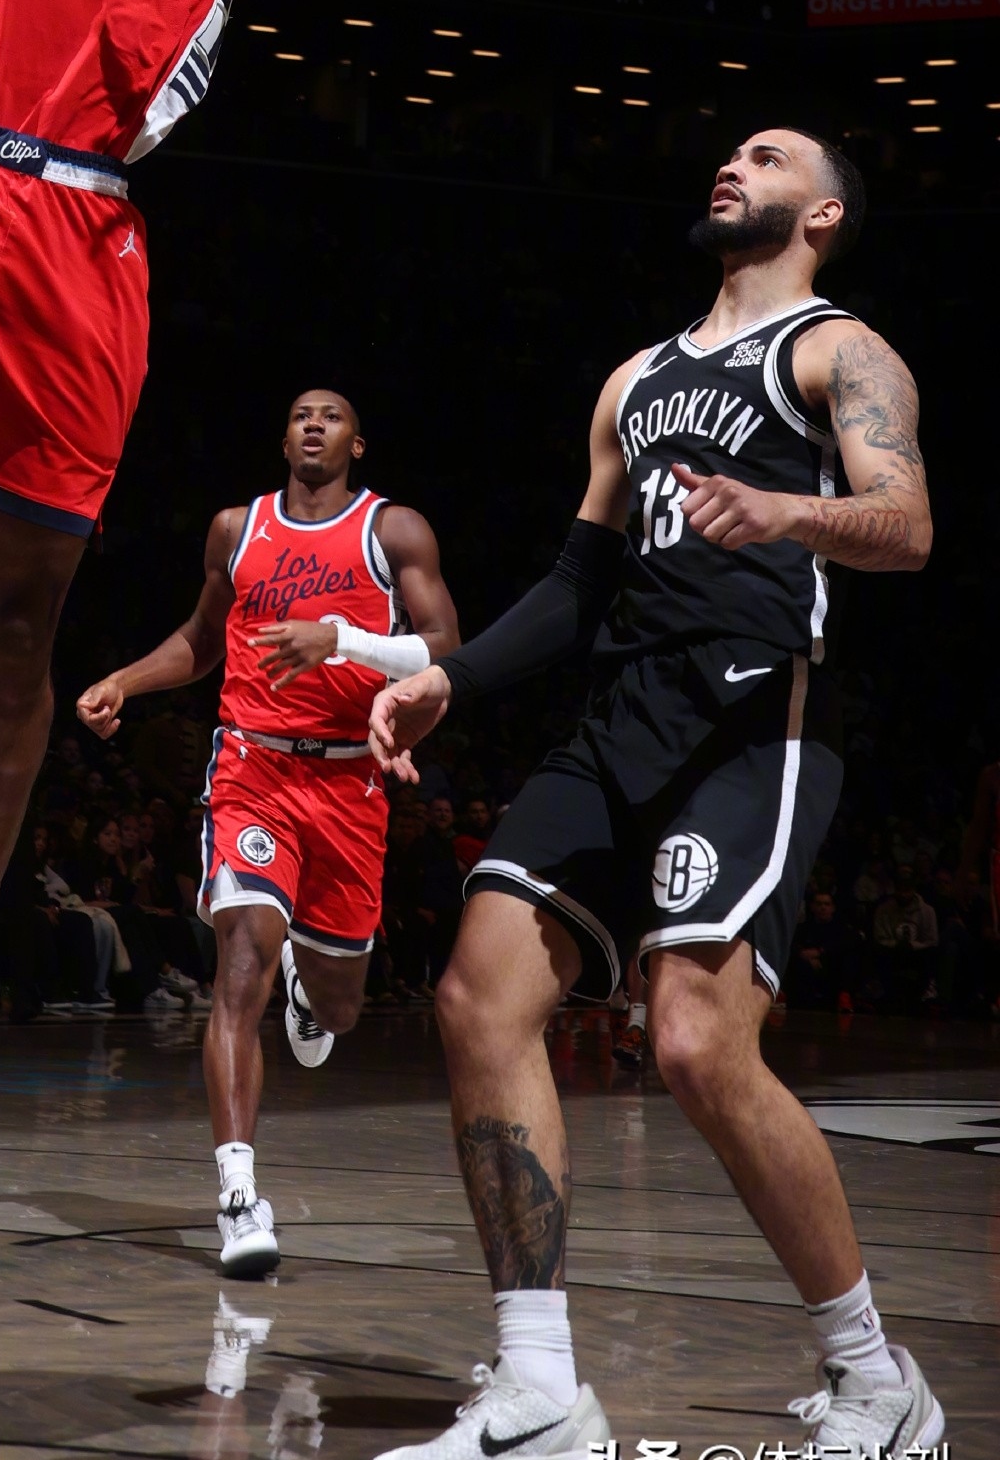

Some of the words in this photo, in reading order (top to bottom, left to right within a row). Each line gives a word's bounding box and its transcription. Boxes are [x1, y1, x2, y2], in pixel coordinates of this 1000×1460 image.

[0, 140, 41, 164] Clips
[732, 345, 766, 359] YOUR
[736, 339, 761, 351] GET
[724, 354, 764, 368] GUIDE
[269, 547, 321, 584] Los
[241, 562, 357, 623] Angeles
[297, 738, 323, 752] Clips
[668, 844, 693, 901] B
